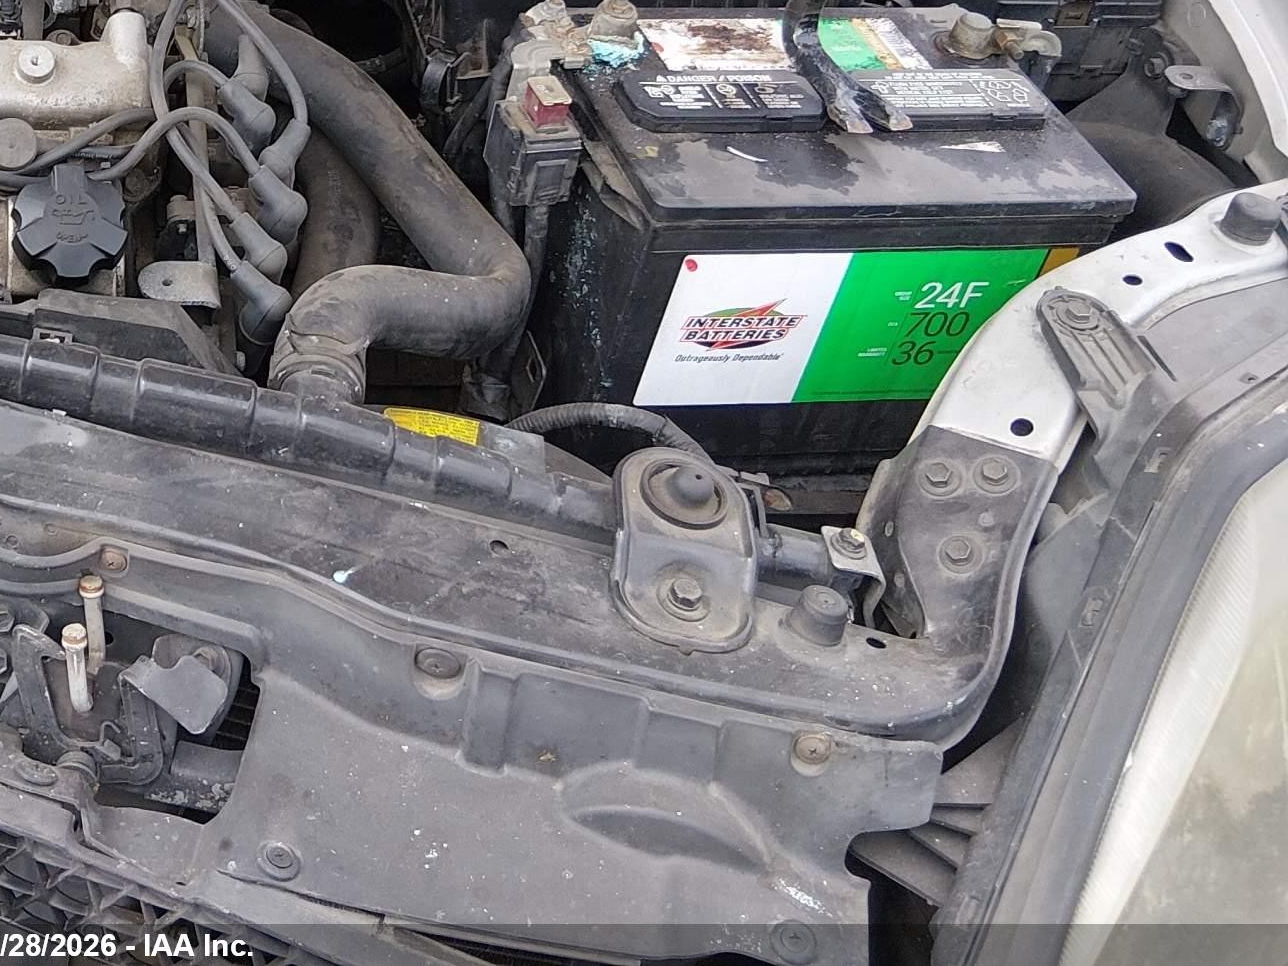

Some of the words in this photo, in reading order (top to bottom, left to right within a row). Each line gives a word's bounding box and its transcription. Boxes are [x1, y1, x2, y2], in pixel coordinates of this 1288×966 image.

[56, 194, 88, 205] OIL
[914, 282, 990, 308] 24F
[686, 316, 800, 328] INTERSTATE
[904, 312, 970, 337] 700
[684, 329, 786, 341] BATTERIES
[891, 341, 937, 366] 36
